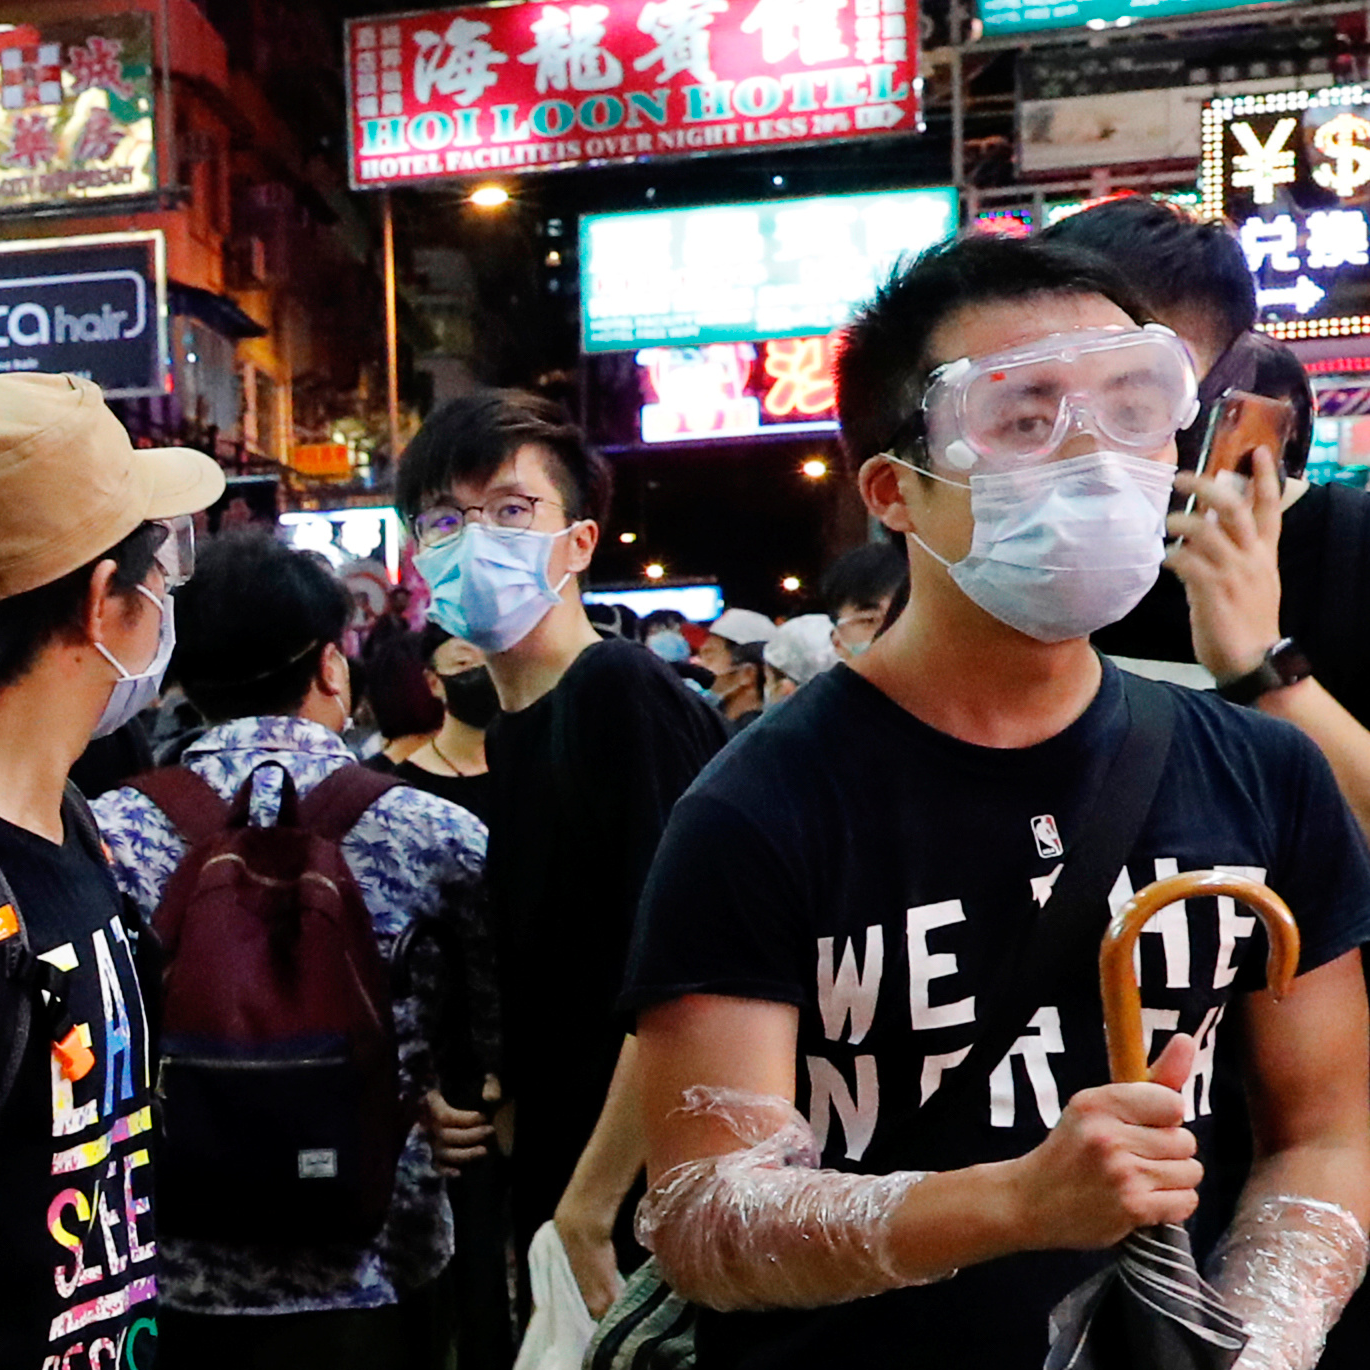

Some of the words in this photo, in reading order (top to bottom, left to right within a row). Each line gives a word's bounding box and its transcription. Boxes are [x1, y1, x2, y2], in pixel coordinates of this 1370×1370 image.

[359, 107, 483, 156] HOI
[491, 87, 670, 143] LOON
[681, 63, 909, 123] HOTEL
[361, 153, 443, 179] HOTEL
[586, 132, 653, 158] OVER
[658, 123, 740, 149] NIGHT
[744, 117, 808, 142] LESS
[54, 303, 129, 344] hair
[817, 899, 976, 1045] WE
